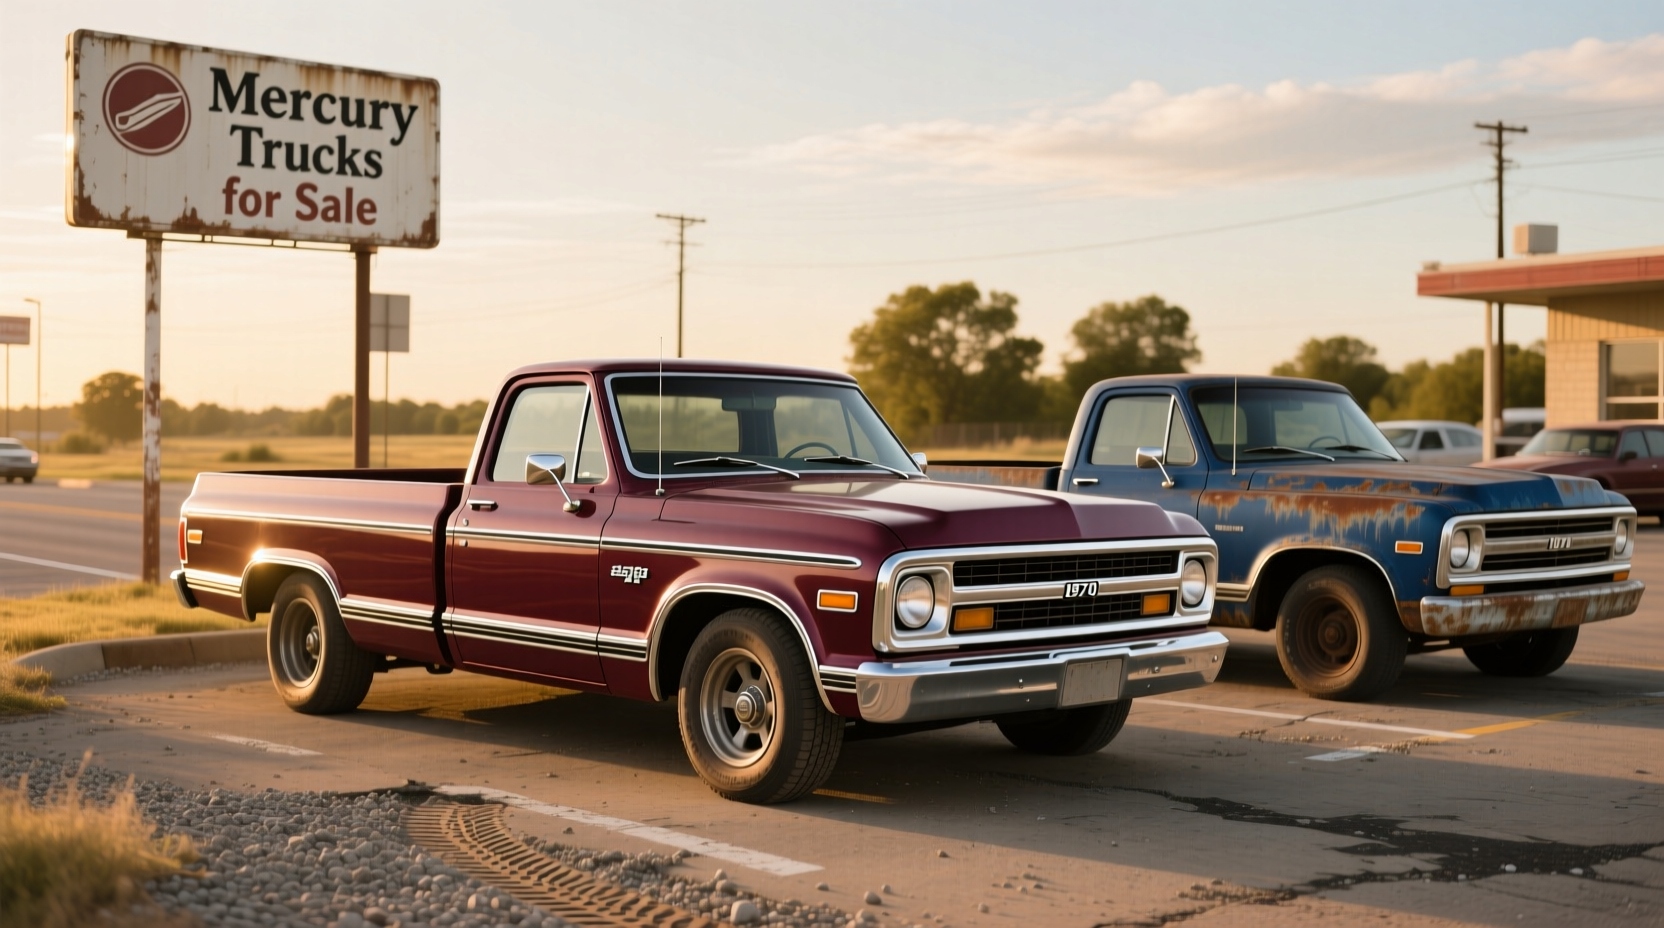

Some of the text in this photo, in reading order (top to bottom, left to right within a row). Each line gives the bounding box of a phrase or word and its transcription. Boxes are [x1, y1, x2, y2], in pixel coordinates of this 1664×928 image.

[208, 66, 419, 147] Mercury
[229, 124, 383, 179] Trucks
[222, 175, 378, 226] for Sale
[1064, 581, 1098, 598] 1970
